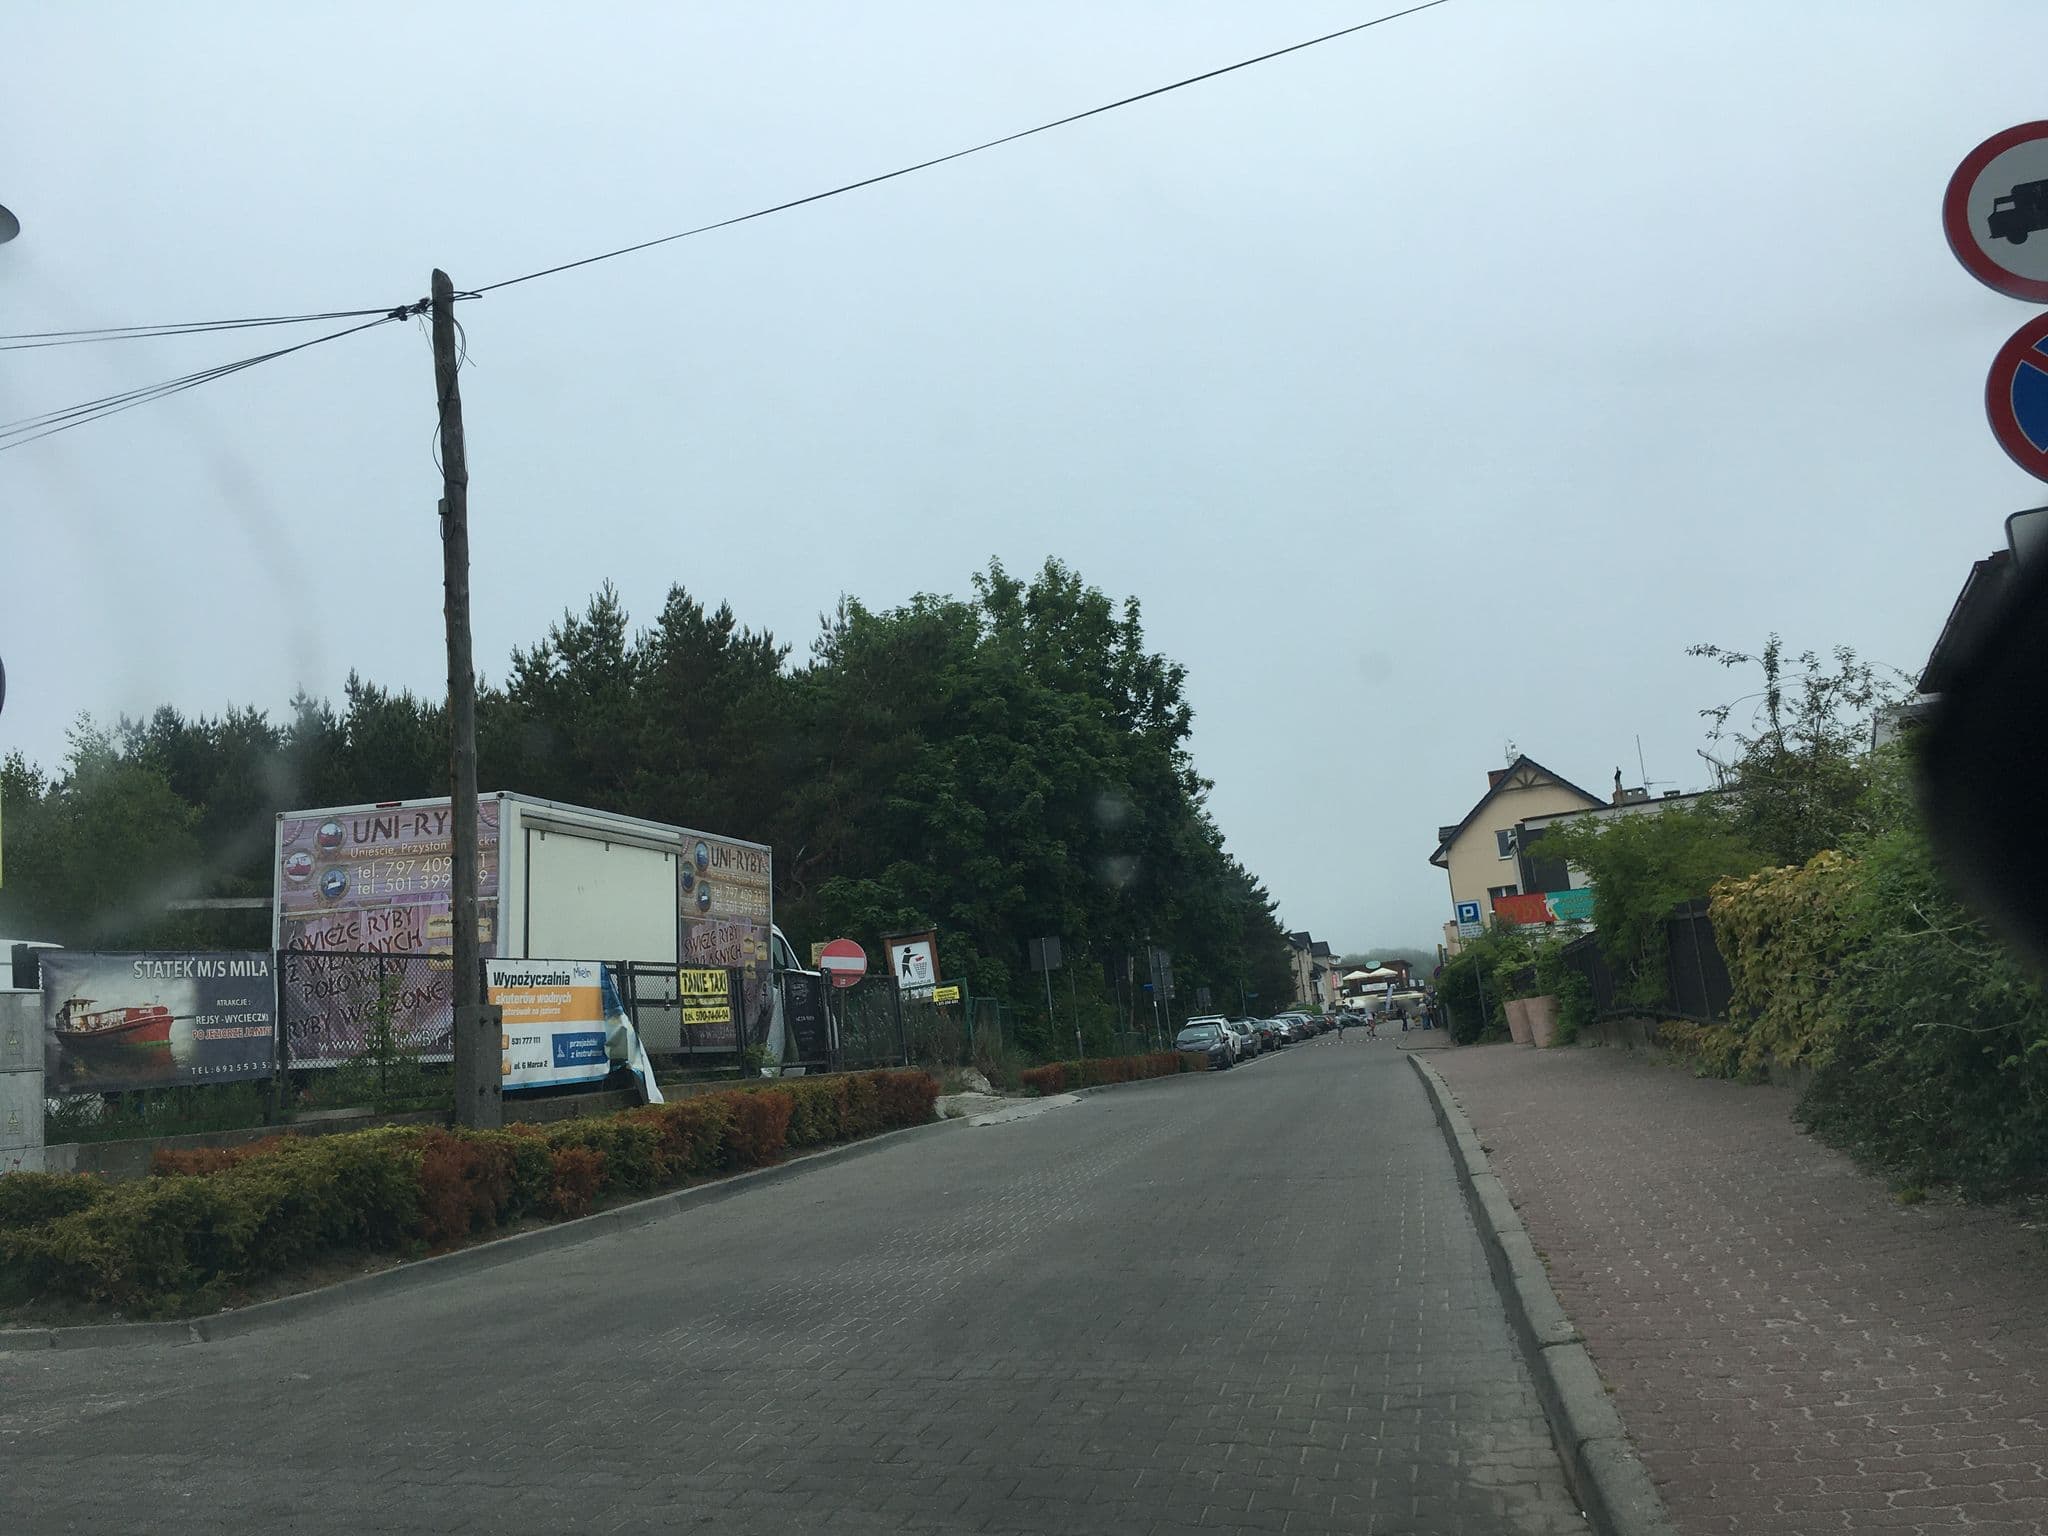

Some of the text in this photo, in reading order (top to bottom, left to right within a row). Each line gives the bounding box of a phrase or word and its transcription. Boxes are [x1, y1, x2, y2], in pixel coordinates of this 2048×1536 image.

[353, 811, 448, 844] UNI-RY
[358, 857, 452, 878] tel. 797 409
[711, 846, 763, 872] UNI-RYBY
[358, 873, 451, 895] tel. 501 399
[725, 886, 738, 899] 797
[368, 908, 412, 935] RYBY
[1463, 906, 1475, 921] P
[718, 924, 738, 943] RYBY
[133, 960, 269, 979] STATEK M/S MILA
[493, 971, 571, 989] Wypożyczalnia
[682, 972, 727, 993] TANIE TAXI
[288, 1012, 331, 1040] RYBY
[522, 1036, 533, 1045] 777
[533, 1036, 541, 1044] 111
[526, 1061, 543, 1069] Marca
